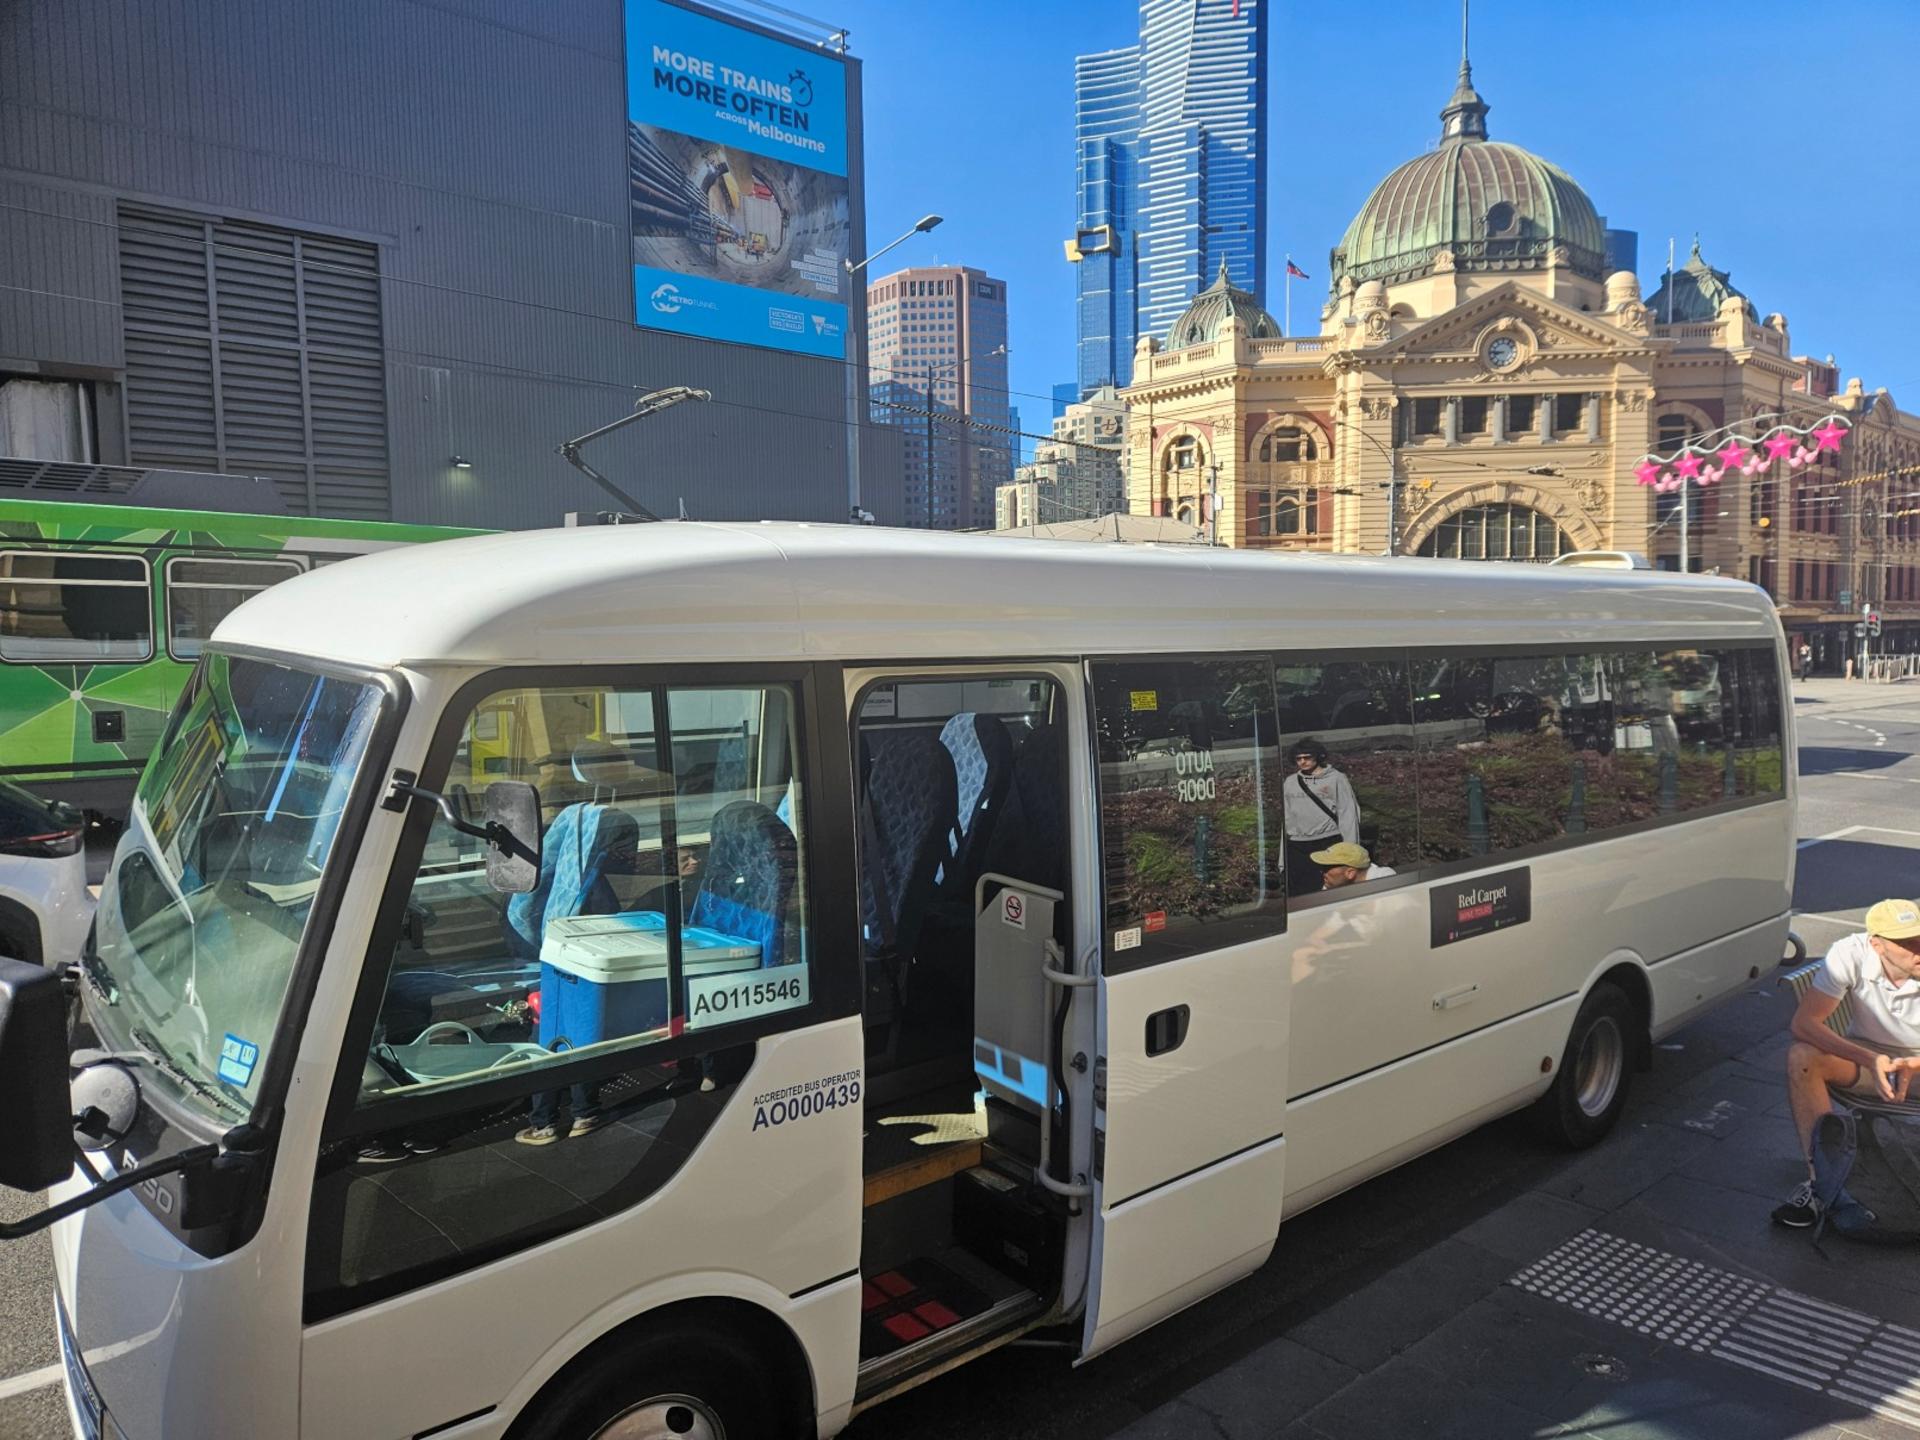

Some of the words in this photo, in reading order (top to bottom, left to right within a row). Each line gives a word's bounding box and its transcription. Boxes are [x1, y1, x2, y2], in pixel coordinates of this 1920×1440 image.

[653, 45, 714, 80] MORE
[720, 66, 792, 104] TRAINS
[654, 68, 727, 108] MORE
[731, 92, 809, 131] OFTEN
[715, 110, 747, 125] ACROSS
[748, 119, 825, 153] Melbourne
[1458, 888, 1476, 909] Red
[1477, 885, 1507, 905] Carpet
[694, 978, 801, 1016] AO115546
[752, 1081, 861, 1131] AO000439
[753, 1083, 803, 1105] ACCREDITED
[804, 1079, 820, 1092] BUS
[821, 1069, 861, 1087] OPERATOR
[122, 1149, 174, 1214] FSO
